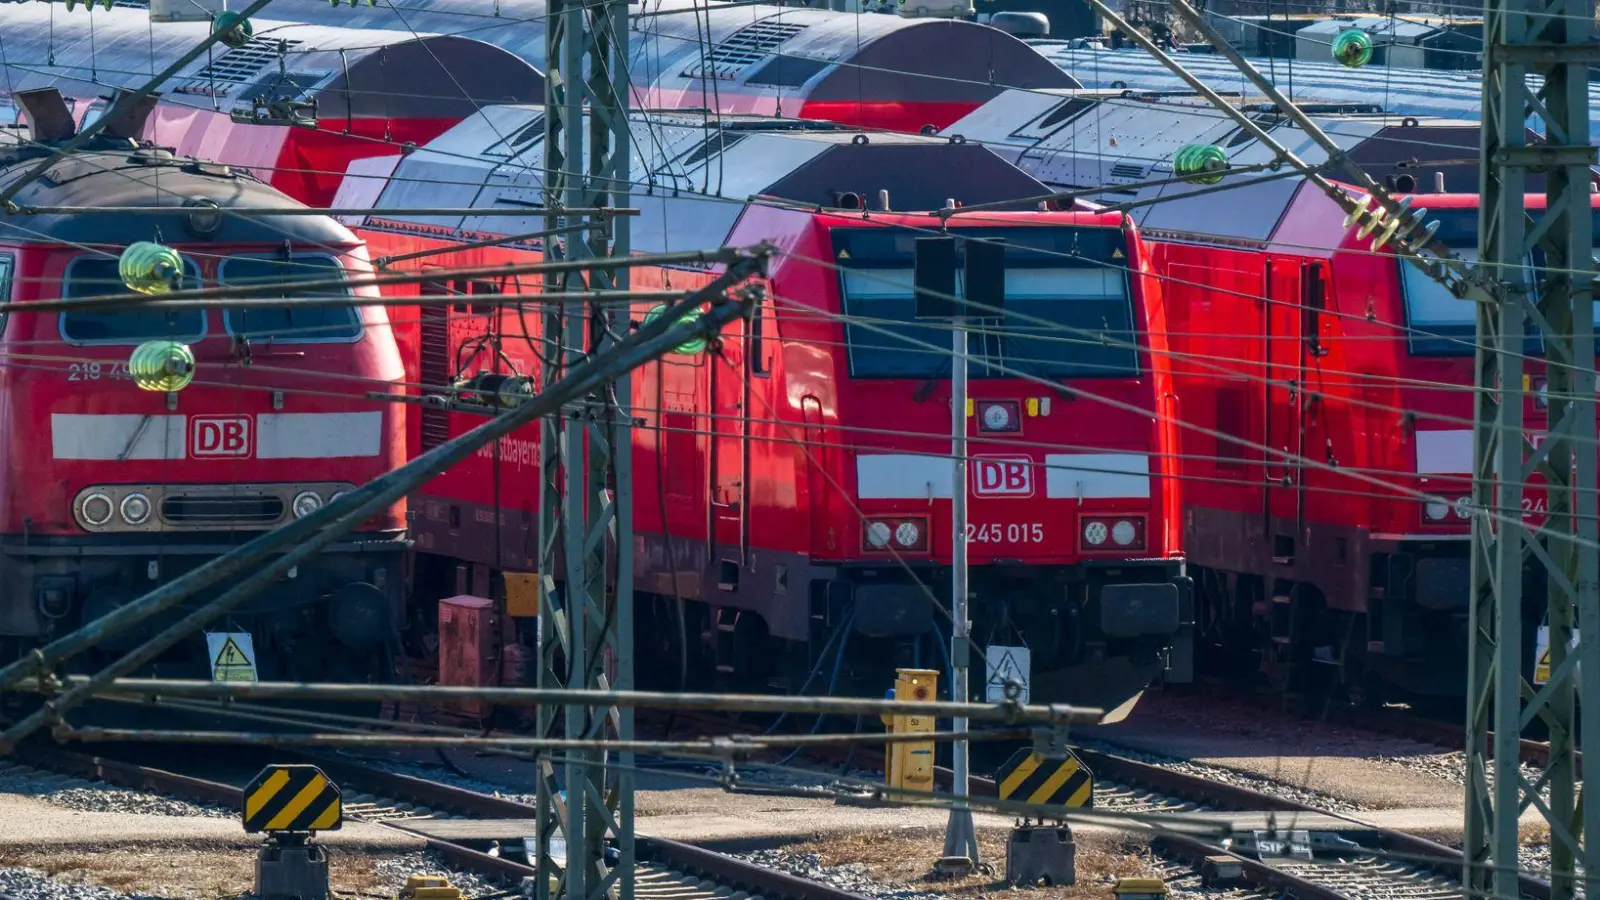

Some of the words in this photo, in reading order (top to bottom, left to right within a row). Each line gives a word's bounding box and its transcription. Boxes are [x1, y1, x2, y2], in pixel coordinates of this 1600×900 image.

[109, 363, 133, 380] 49
[198, 421, 245, 451] DB
[981, 461, 1027, 490] DB
[966, 523, 1003, 543] 245
[1007, 523, 1044, 543] 015
